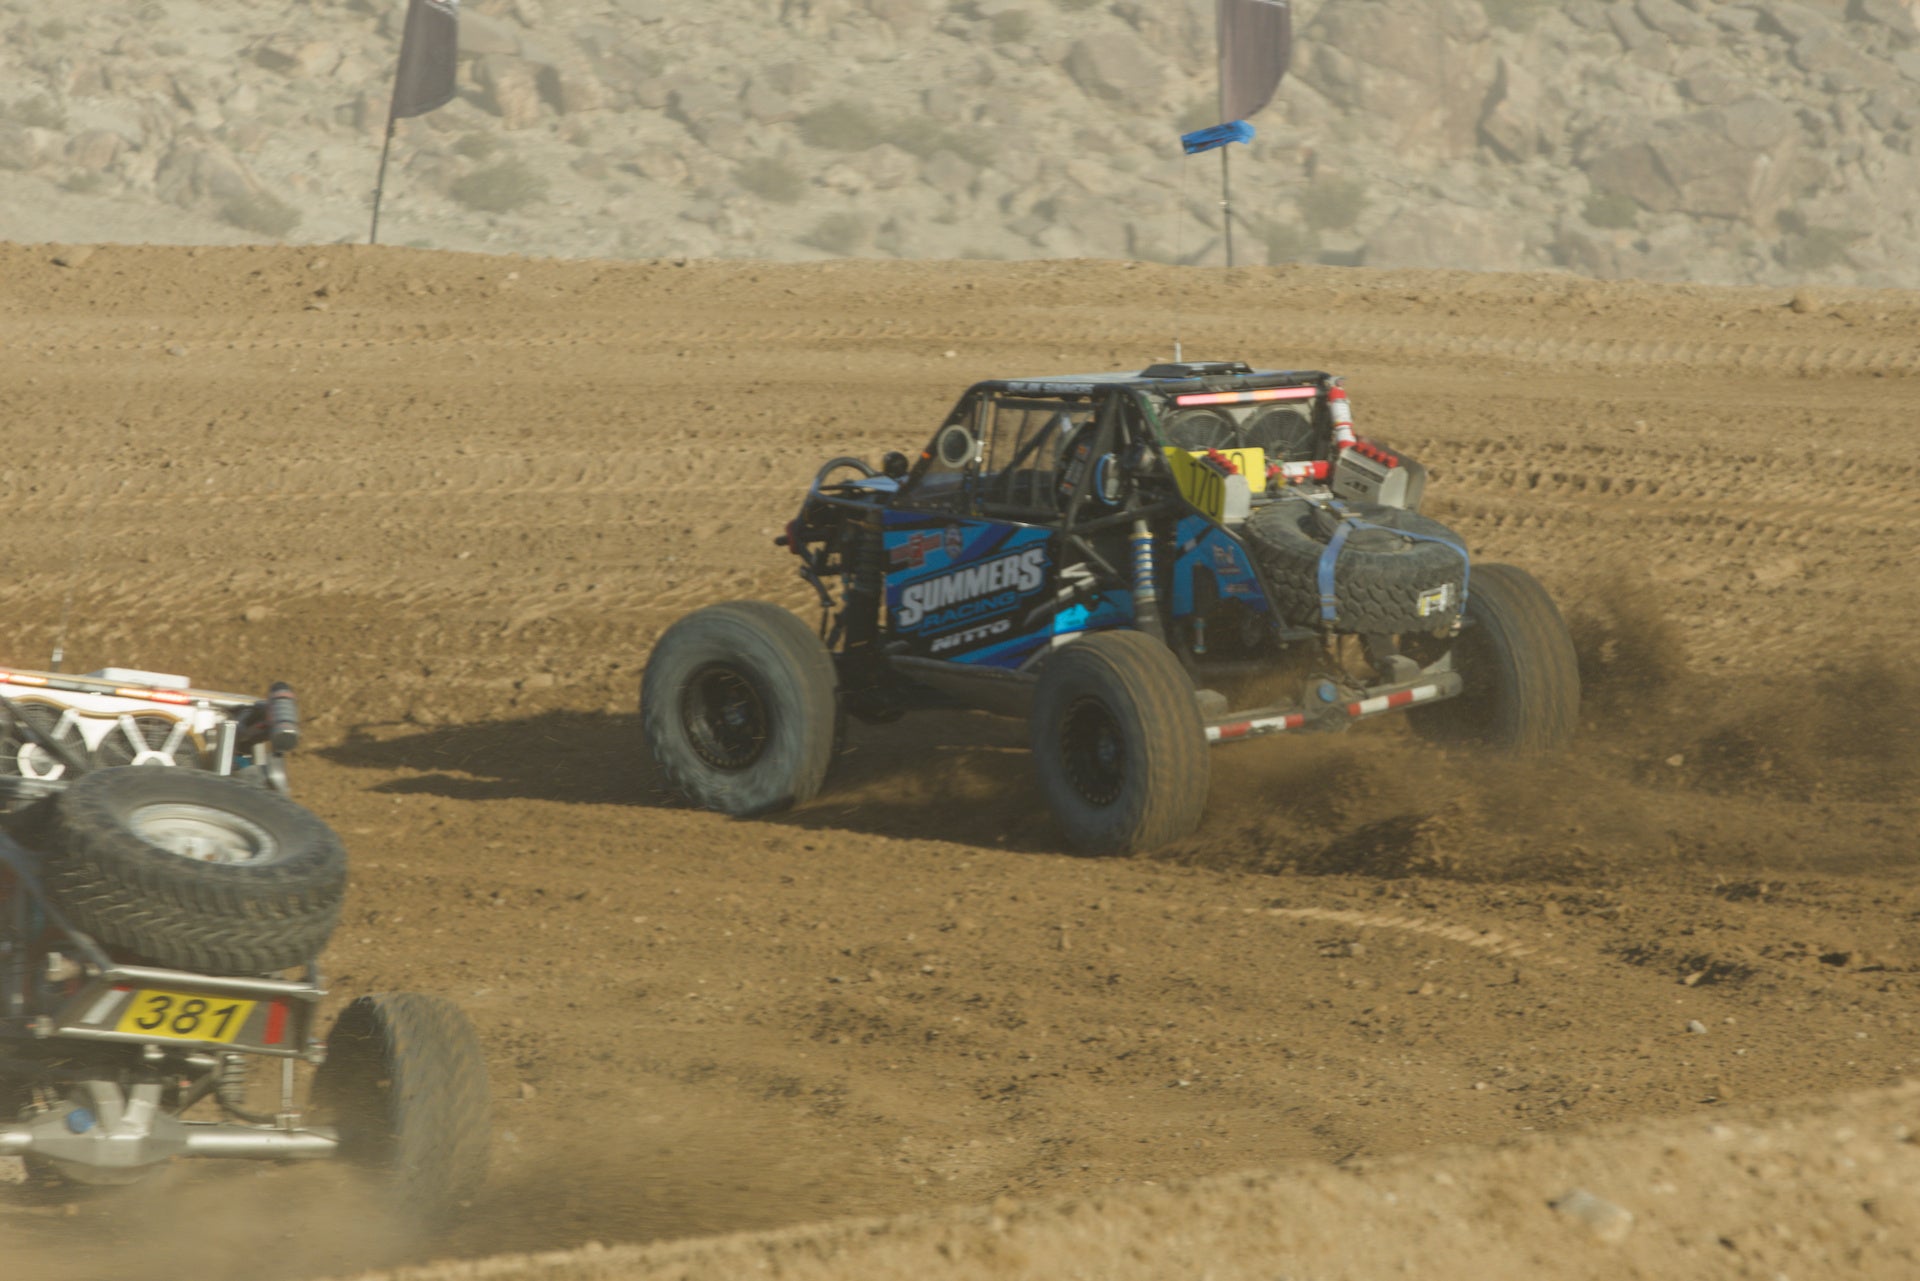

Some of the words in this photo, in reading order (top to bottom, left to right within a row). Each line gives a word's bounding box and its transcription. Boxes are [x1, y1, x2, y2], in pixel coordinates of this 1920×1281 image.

[1189, 460, 1220, 517] 170
[900, 548, 1044, 627] SUMMERS
[923, 591, 1017, 630] RACING
[930, 619, 1012, 652] NITTO
[135, 995, 240, 1038] 381
